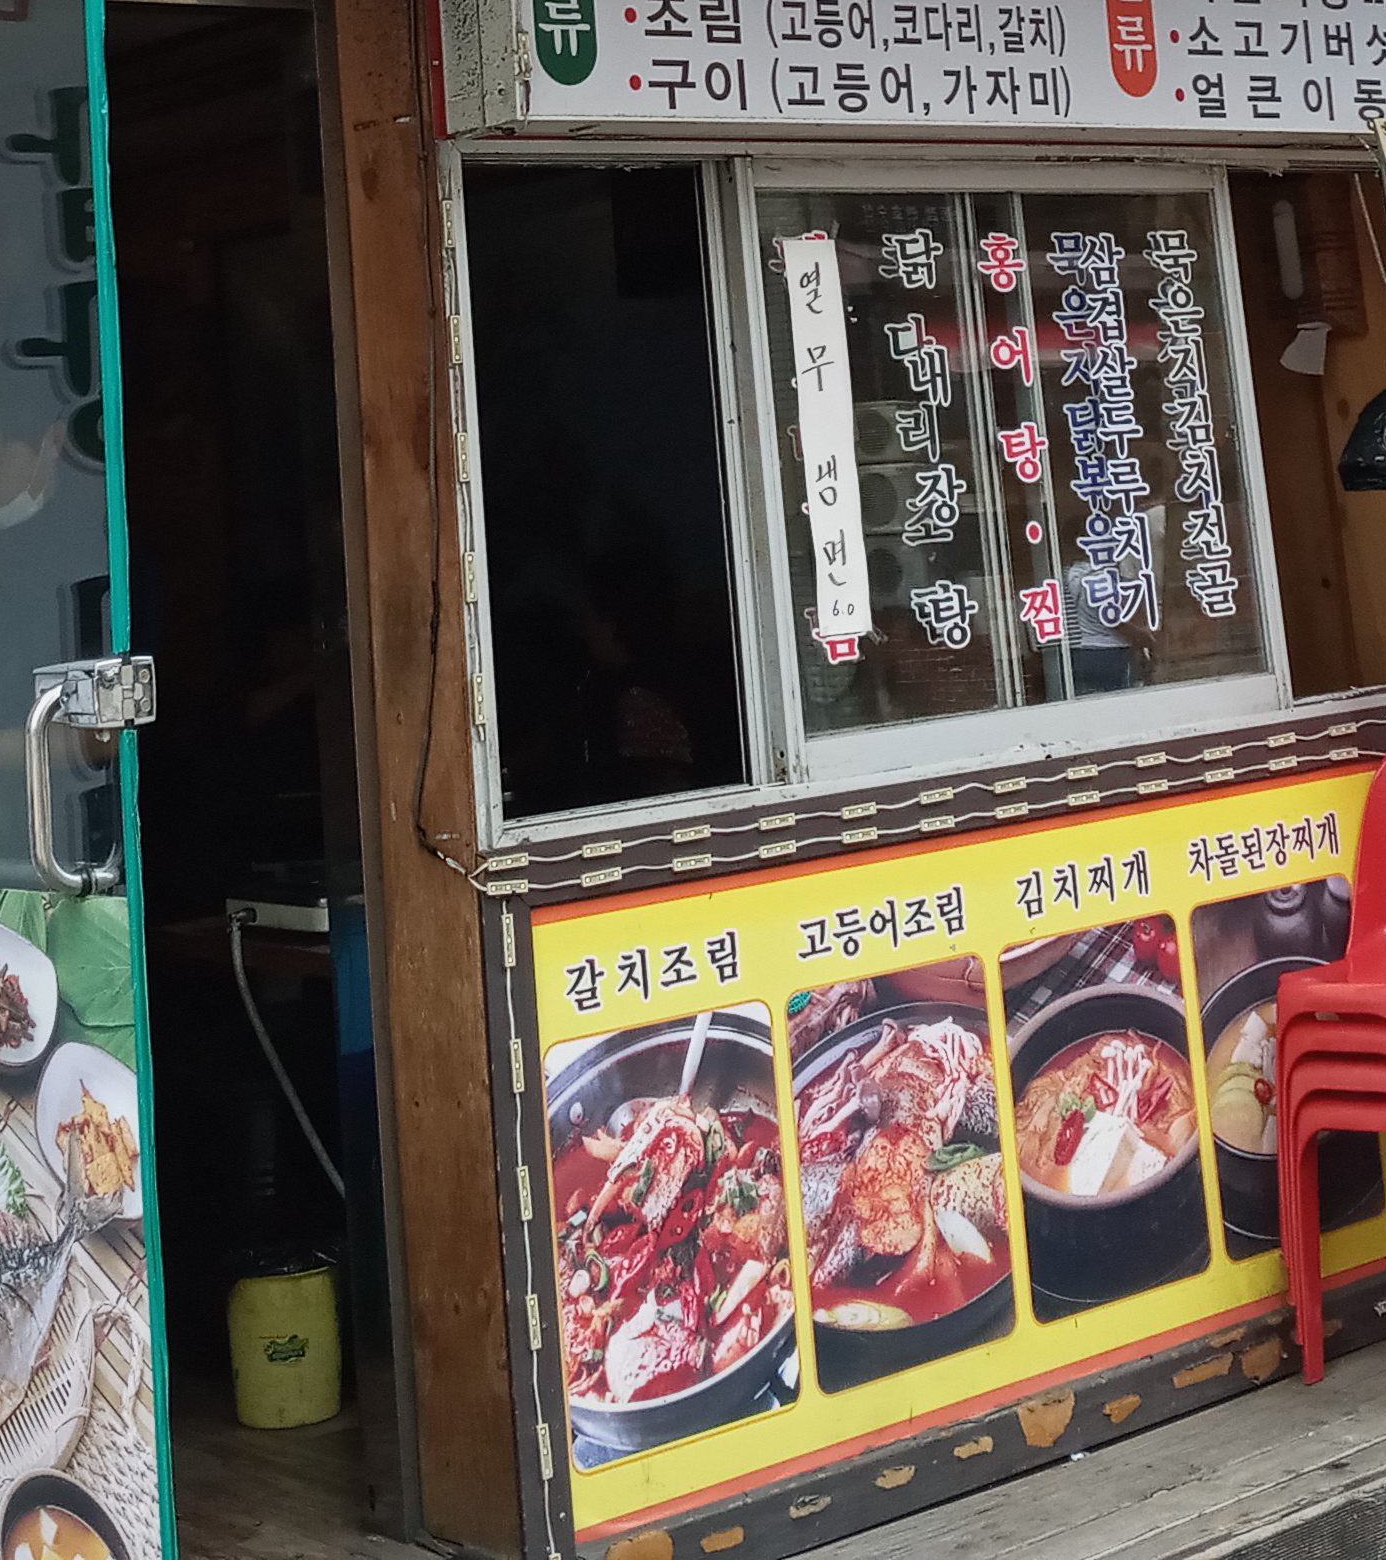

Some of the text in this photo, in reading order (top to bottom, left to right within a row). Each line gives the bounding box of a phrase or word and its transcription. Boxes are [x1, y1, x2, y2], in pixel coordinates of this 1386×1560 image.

[647, 57, 749, 112] 구이
[1186, 810, 1342, 883] 차돌된장찌개
[1014, 848, 1153, 922] 김치찌개
[795, 885, 969, 962] 고등어조림
[562, 929, 743, 1015] 갈치조림
